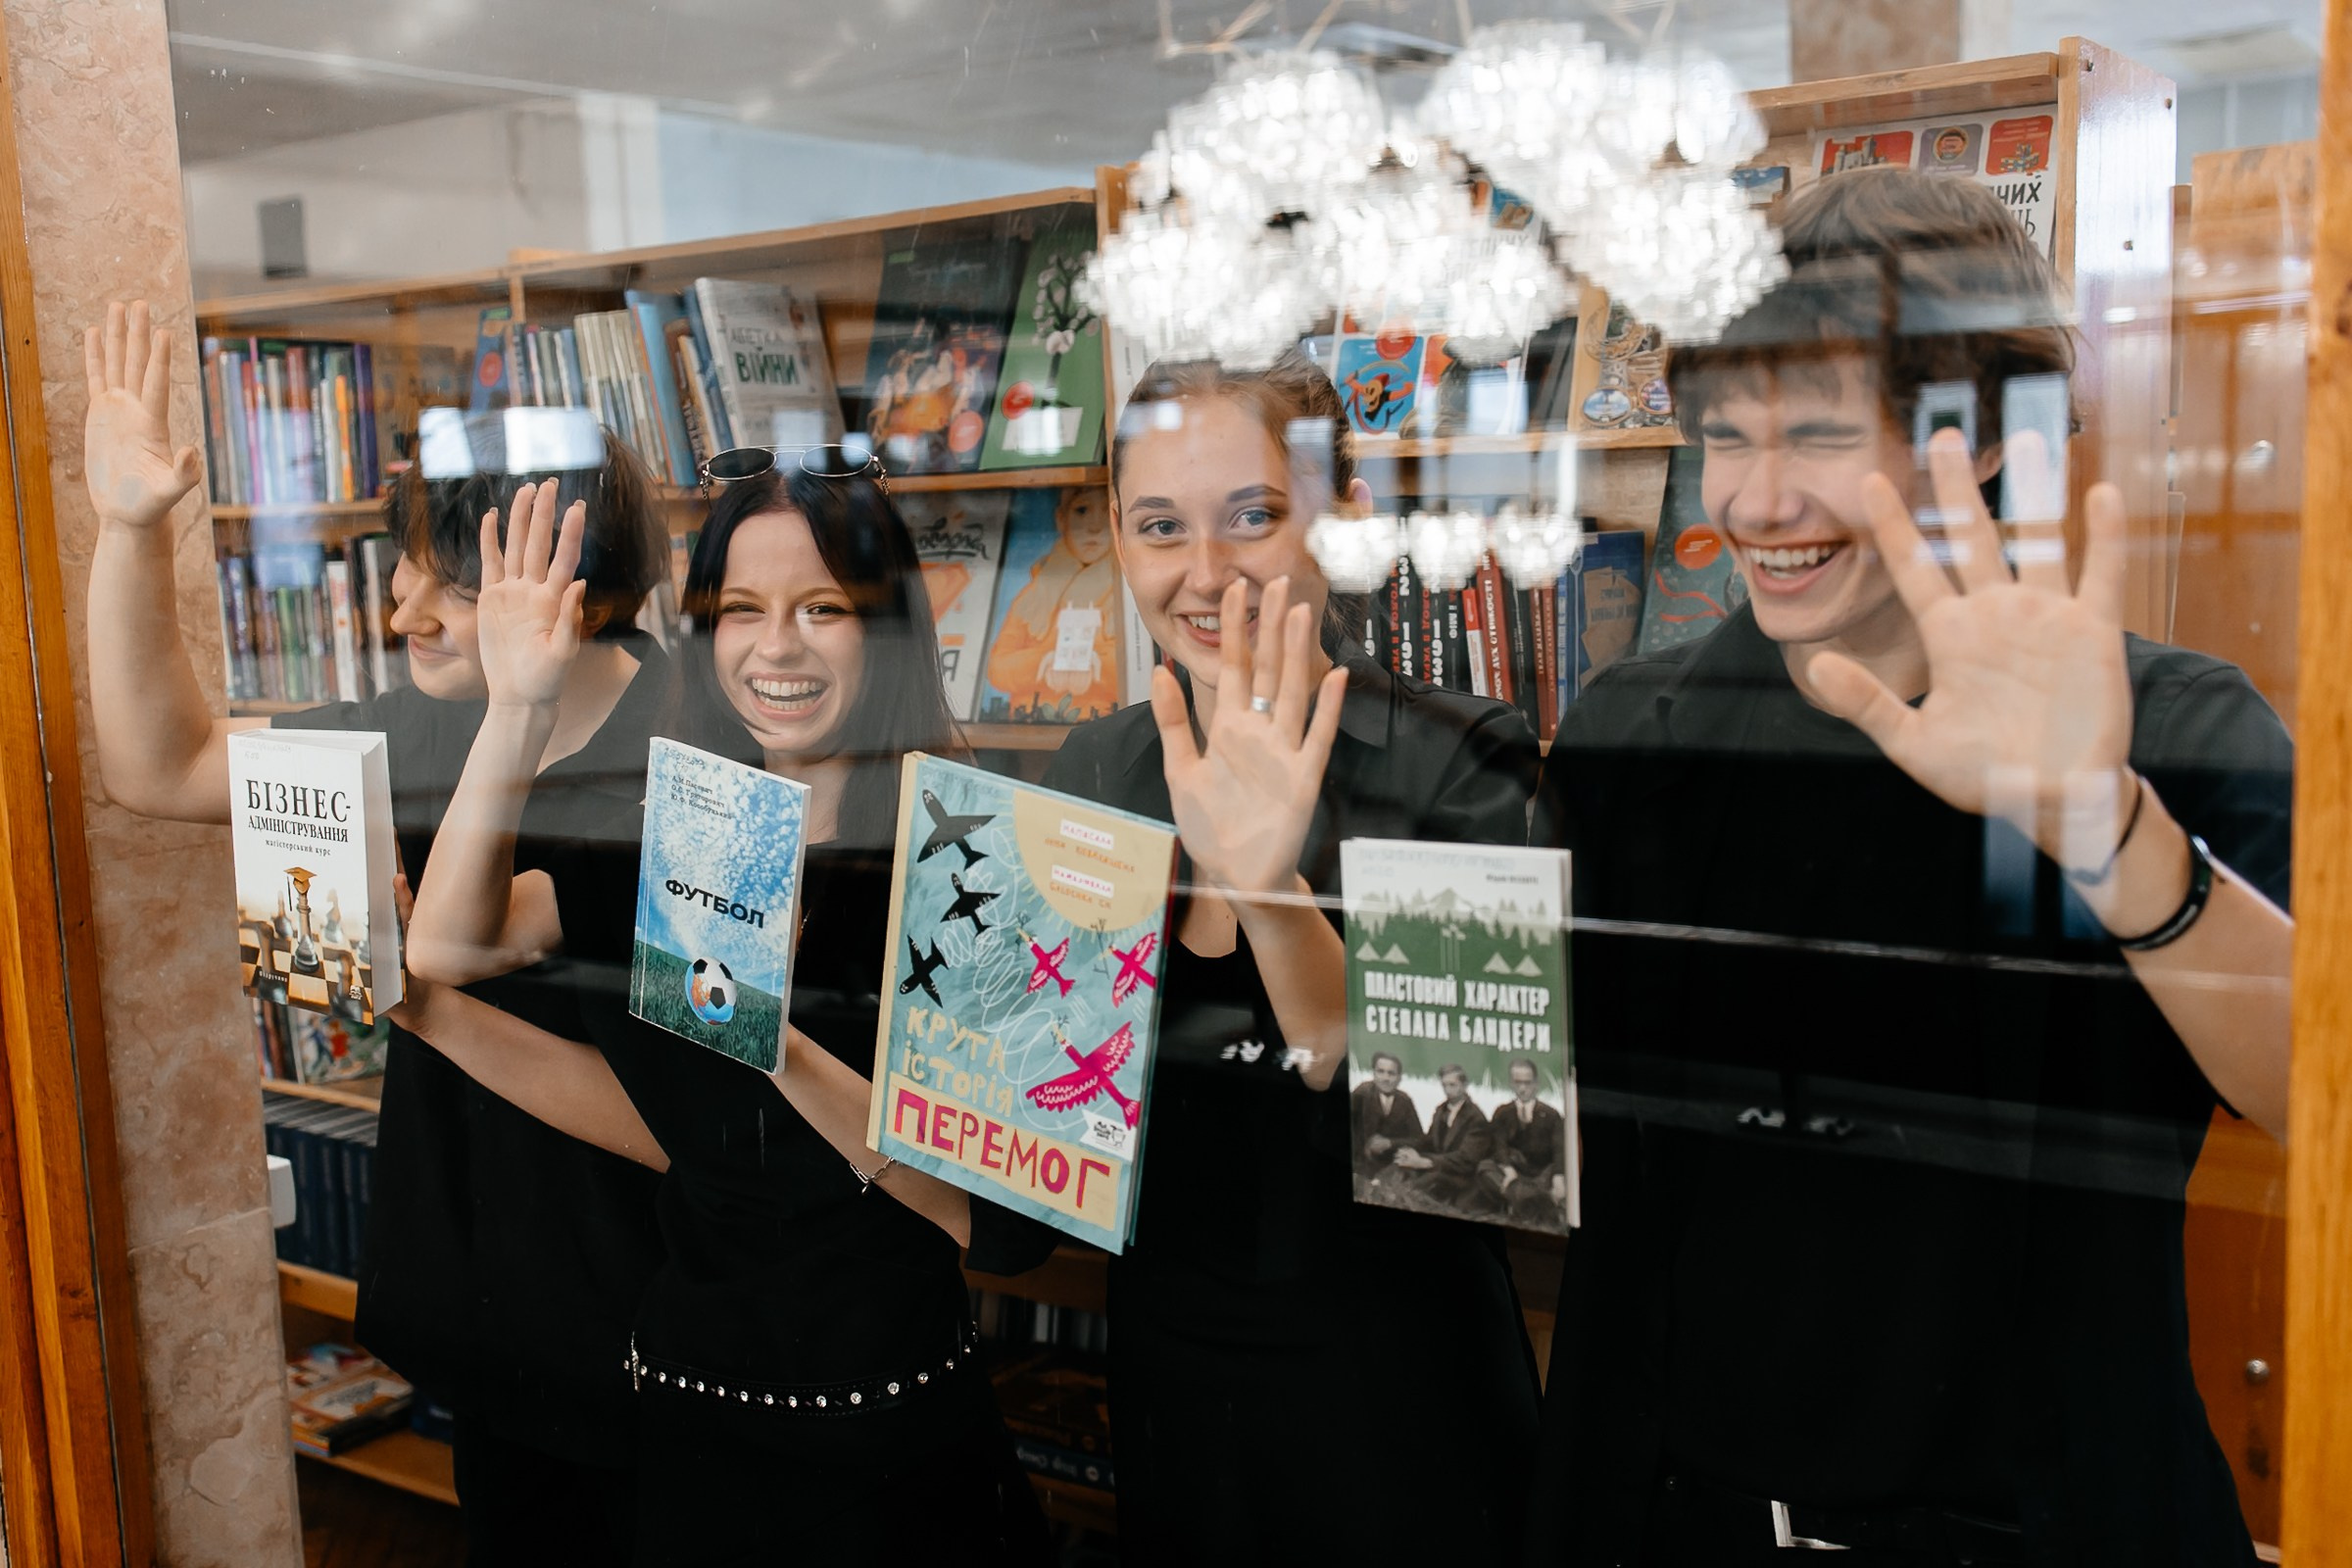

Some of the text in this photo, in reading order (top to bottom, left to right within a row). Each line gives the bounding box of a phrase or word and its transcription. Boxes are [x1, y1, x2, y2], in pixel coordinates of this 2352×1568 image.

[1422, 586, 1431, 630] ОЛОД
[1392, 649, 1400, 673] УКР
[245, 779, 351, 823] БІЗНЕС-
[248, 814, 349, 843] АДМІНІСТРУВАННЯ
[664, 878, 764, 929] ФУТБОЛ
[1364, 970, 1550, 1016] ПЛАСТОВИЙ ХАРАКТЕР
[906, 1005, 1006, 1076] КРУТА
[1365, 1004, 1550, 1053] СТЕПАНА БАНДЕРИ
[893, 1088, 1110, 1209] ПЕРЕМОГ
